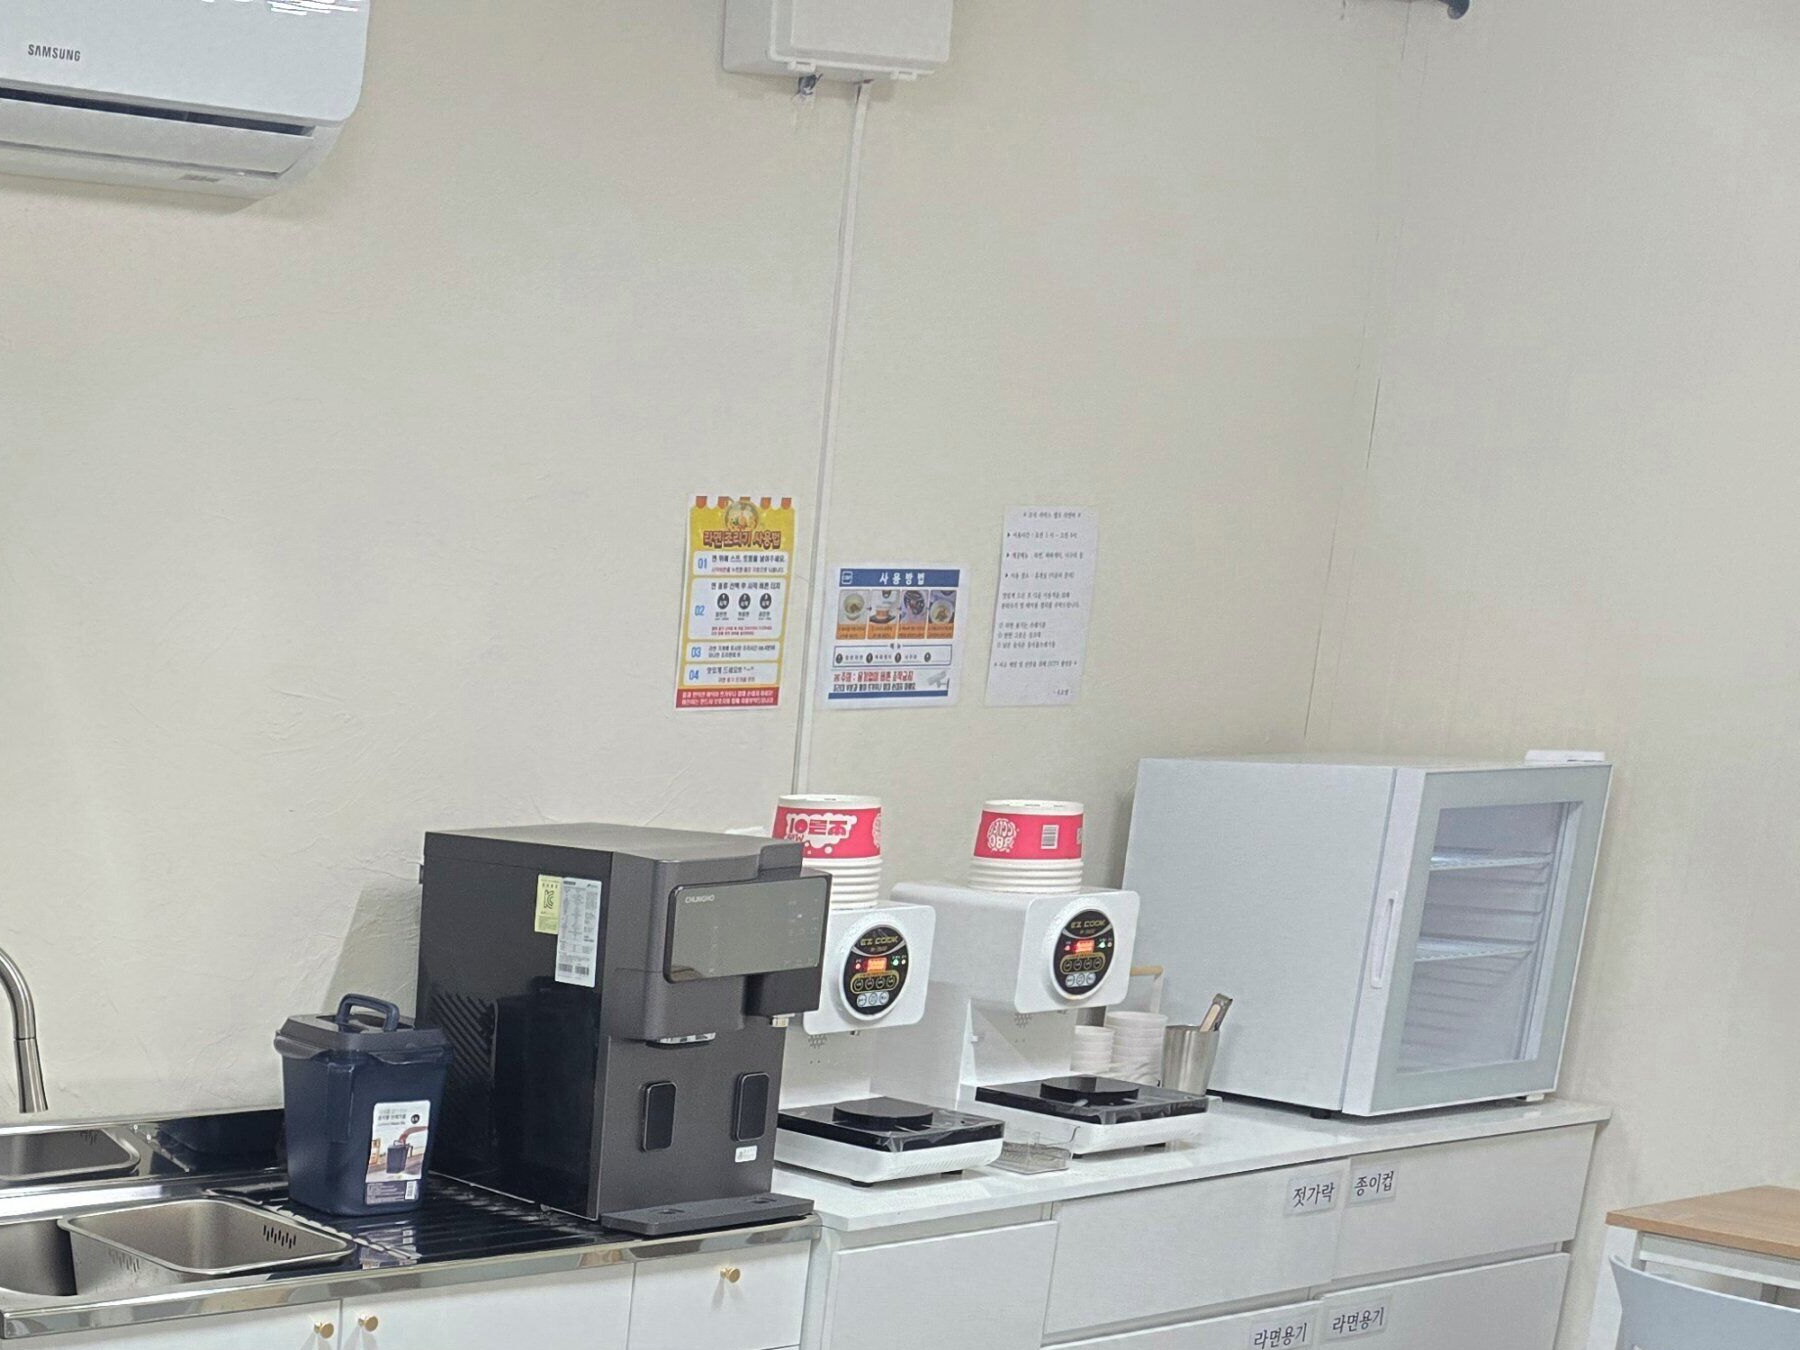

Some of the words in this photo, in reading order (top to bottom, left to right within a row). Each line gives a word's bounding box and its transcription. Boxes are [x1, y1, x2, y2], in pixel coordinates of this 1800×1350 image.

[28, 44, 81, 62] SAMSUNG
[697, 559, 707, 569] 01
[694, 605, 705, 616] 02
[691, 647, 701, 658] 03
[688, 670, 699, 680] 04
[875, 935, 899, 945] COOK
[1355, 1170, 1394, 1197] 종이컵
[1292, 1181, 1335, 1207] 젓가락
[1332, 1305, 1386, 1333] 라면용기
[1253, 1322, 1308, 1349] 라면용기
